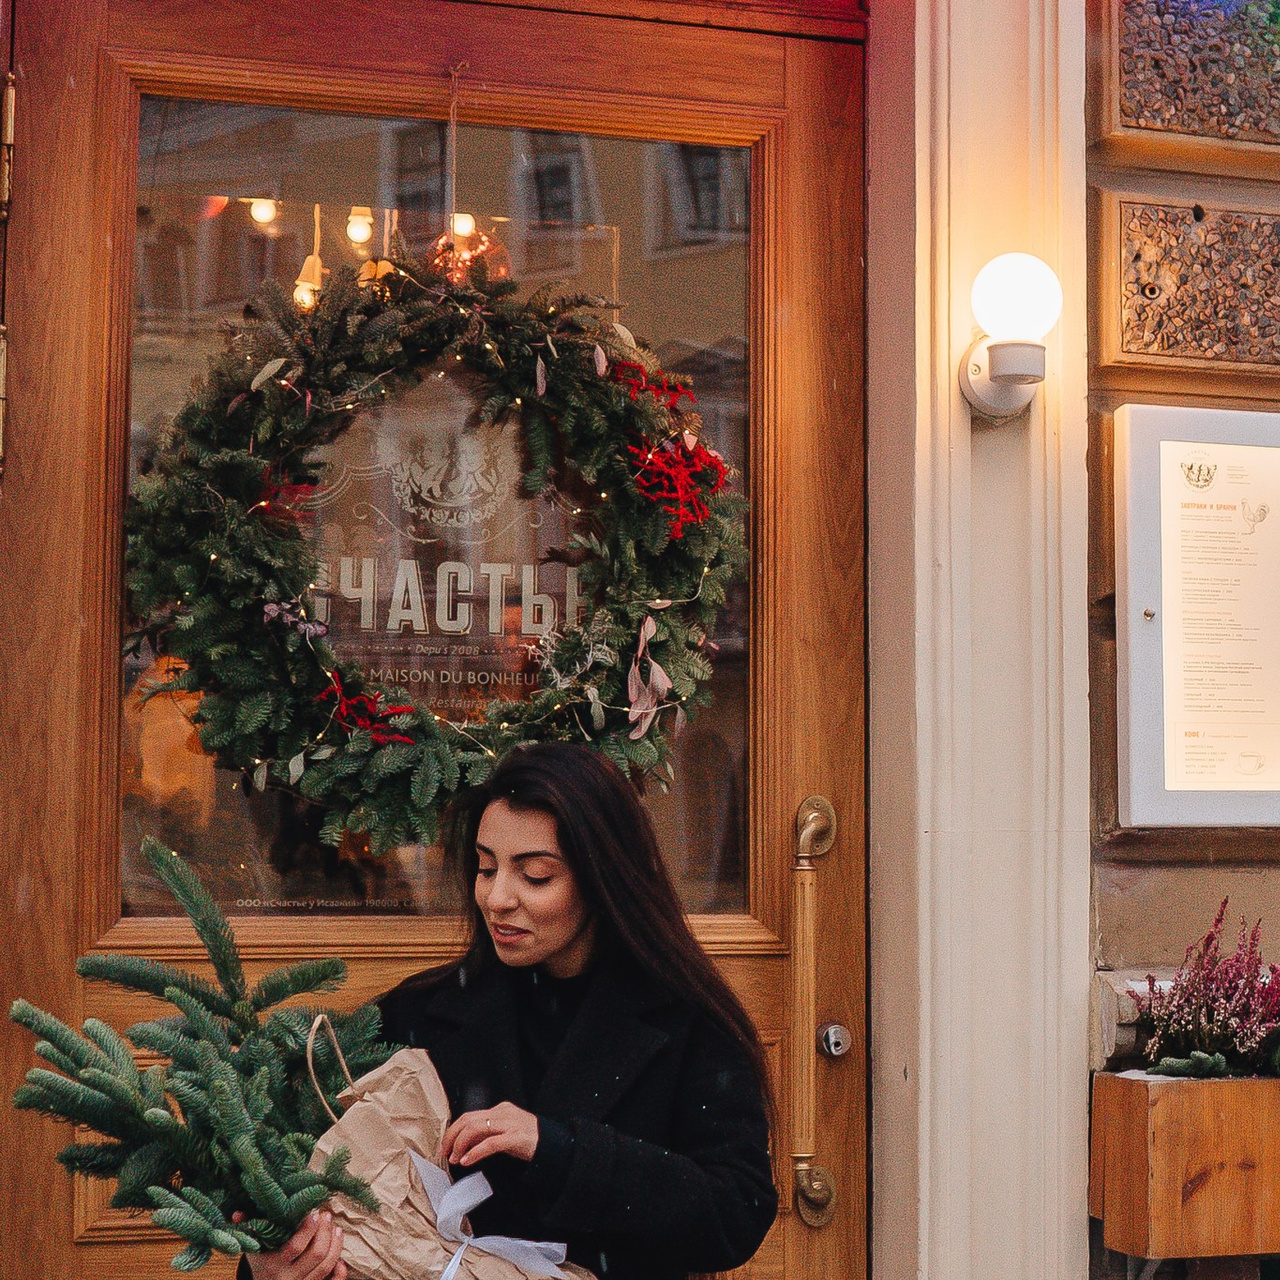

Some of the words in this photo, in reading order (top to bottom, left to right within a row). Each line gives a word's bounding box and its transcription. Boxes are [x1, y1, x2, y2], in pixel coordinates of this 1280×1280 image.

[1181, 502, 1207, 510] ЗАВТРАКИ
[450, 645, 480, 656] 2008
[370, 668, 434, 683] MAISON
[440, 670, 462, 684] DU
[468, 671, 539, 686] BONHEU
[236, 899, 261, 908] ООО
